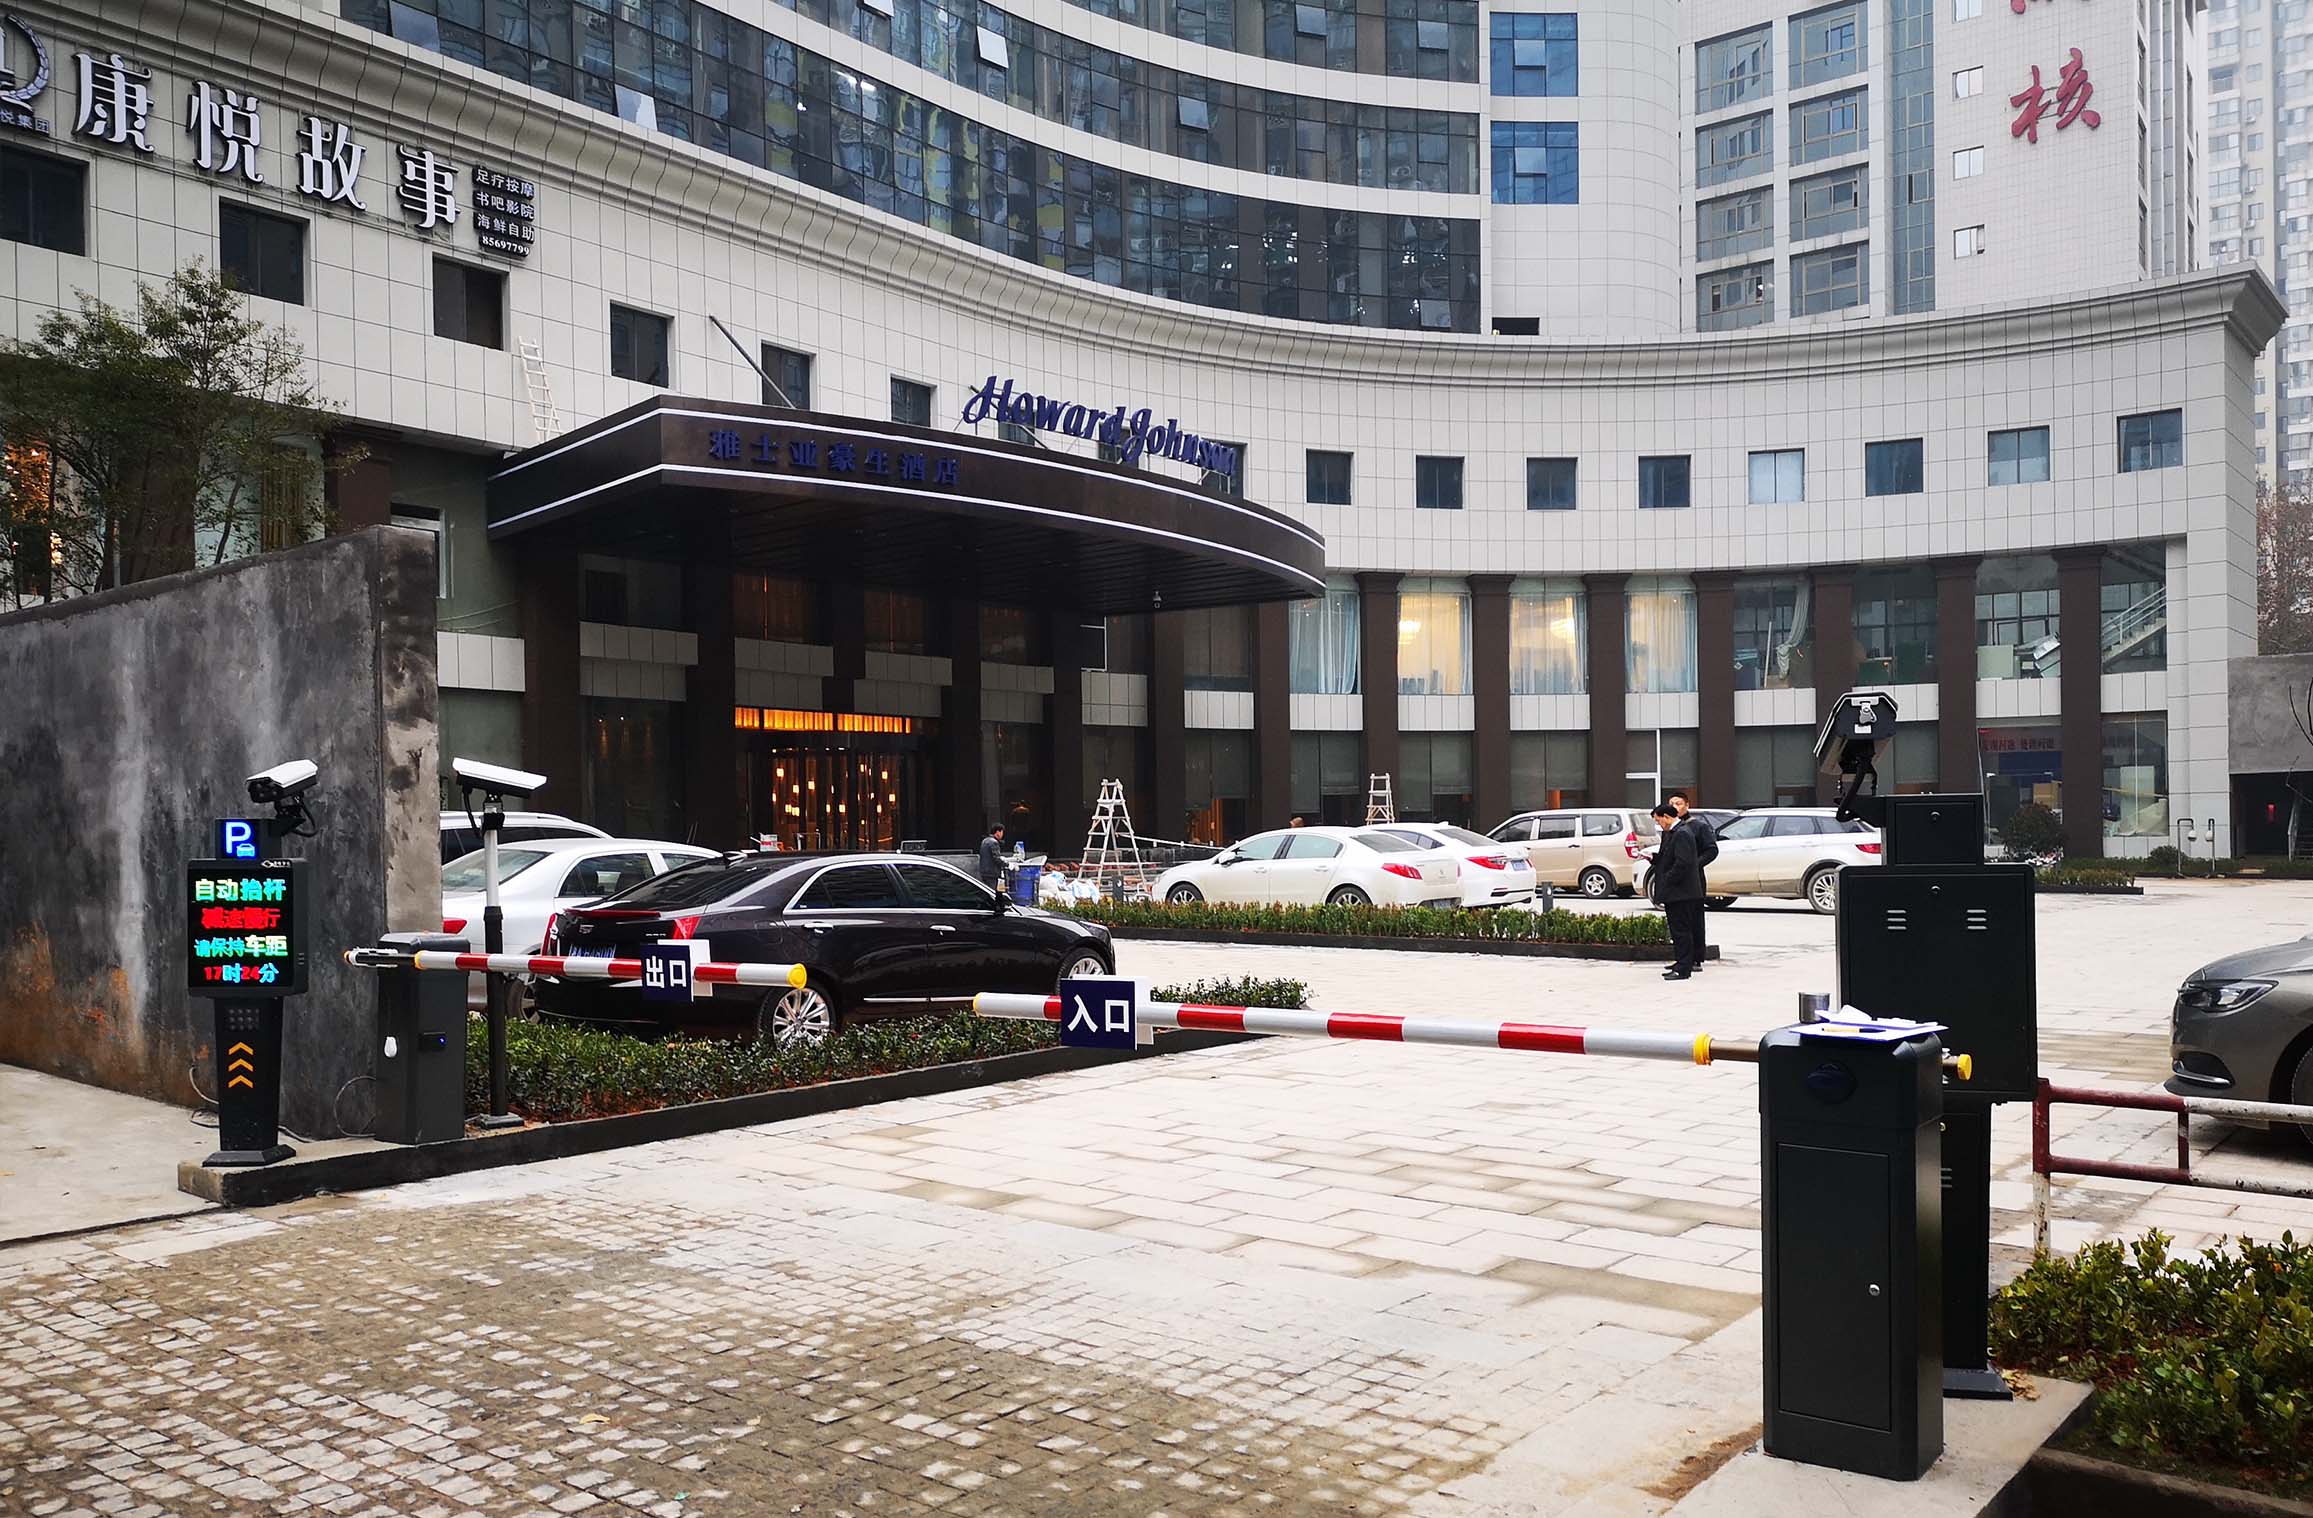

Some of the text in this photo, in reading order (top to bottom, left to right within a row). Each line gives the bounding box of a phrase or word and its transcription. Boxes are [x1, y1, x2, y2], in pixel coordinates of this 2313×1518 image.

[75, 53, 460, 230] 康悦故事
[476, 168, 535, 198] 足疗按摩
[476, 191, 535, 220] 书吧影院
[477, 213, 535, 242] 海鲜自助
[481, 235, 530, 256] 85697799
[962, 375, 1236, 477] Howard Johnson
[708, 429, 961, 487] 雅士亚豪生酒店
[225, 821, 252, 854] P
[194, 878, 287, 902] 自动抬杆
[194, 935, 289, 958] 请保持车距
[204, 963, 280, 984] 17时24分
[645, 955, 688, 989] 出口
[1067, 994, 1131, 1034] 入口
